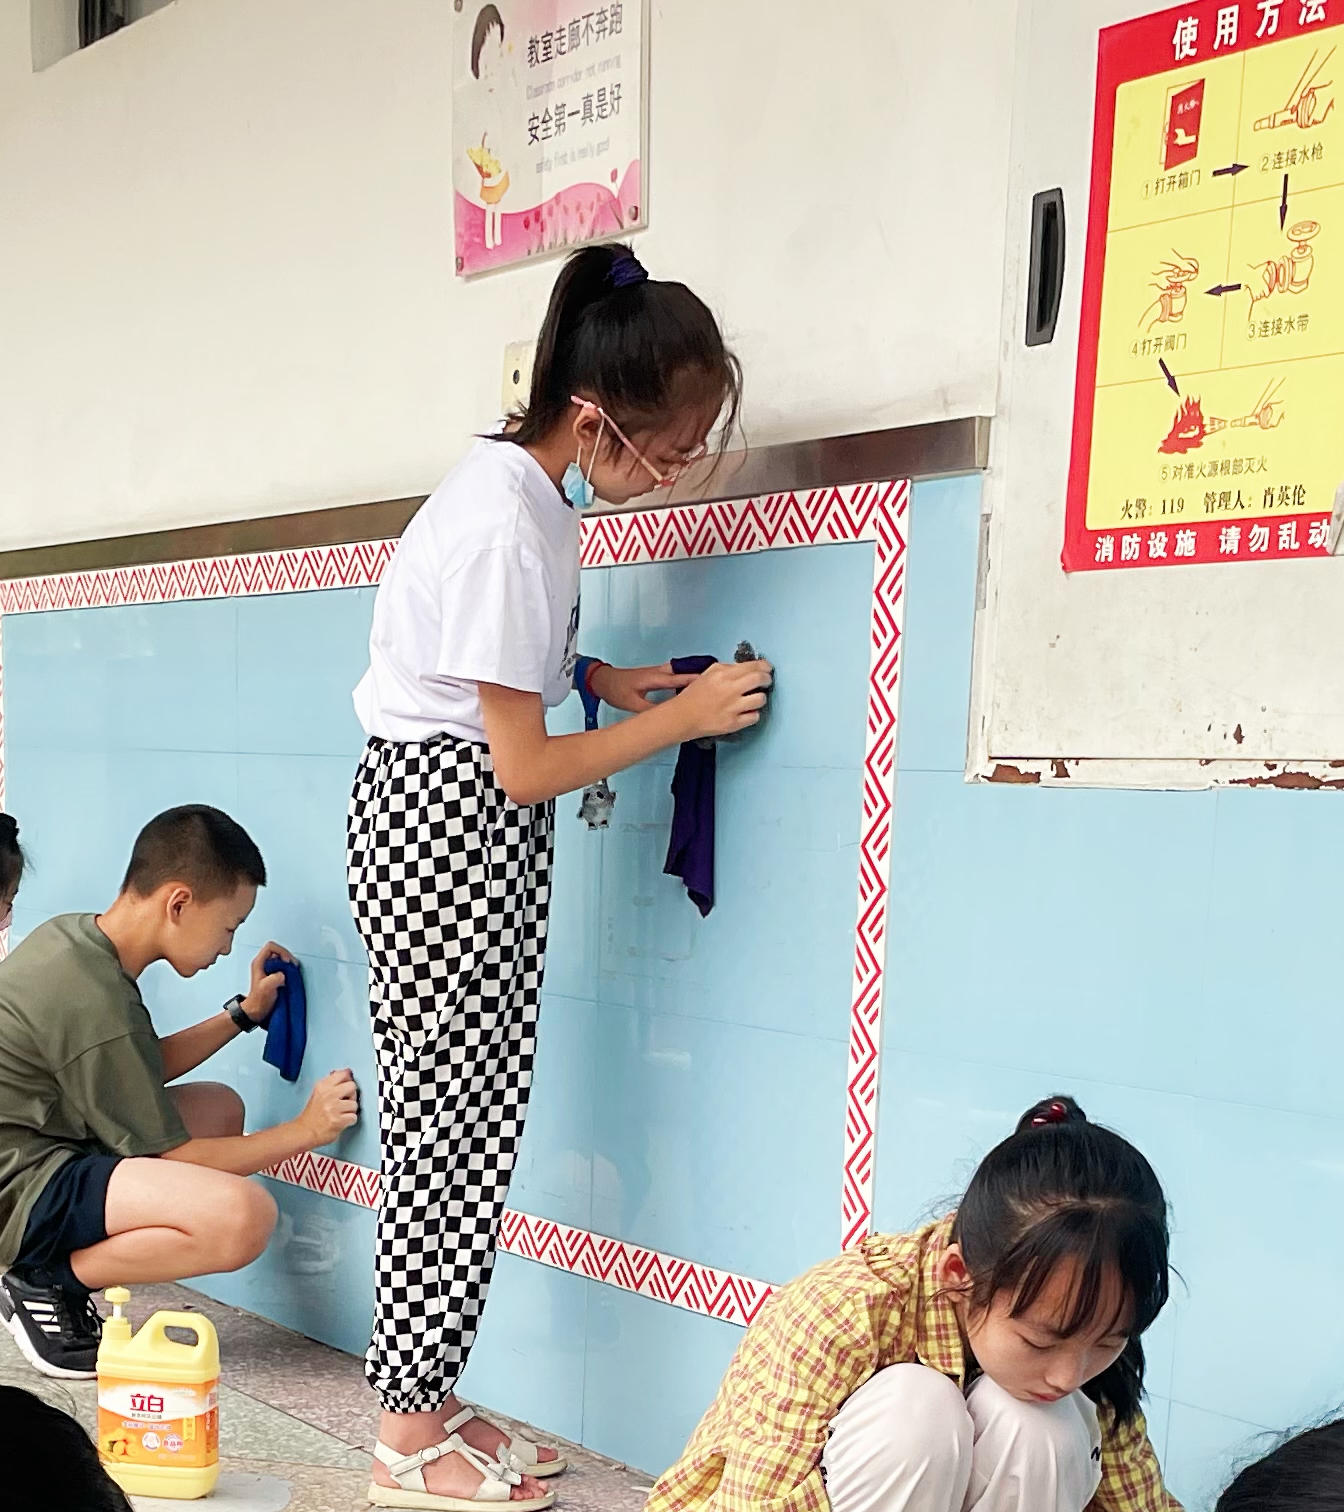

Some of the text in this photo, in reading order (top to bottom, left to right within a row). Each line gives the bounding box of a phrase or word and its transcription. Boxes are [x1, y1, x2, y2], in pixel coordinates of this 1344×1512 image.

[1172, 0, 1328, 61] 使用方法
[527, 83, 623, 146] 安全第一真是好
[1095, 519, 1331, 563] 消防设施 请勿乱动
[130, 1394, 164, 1413] 立白
